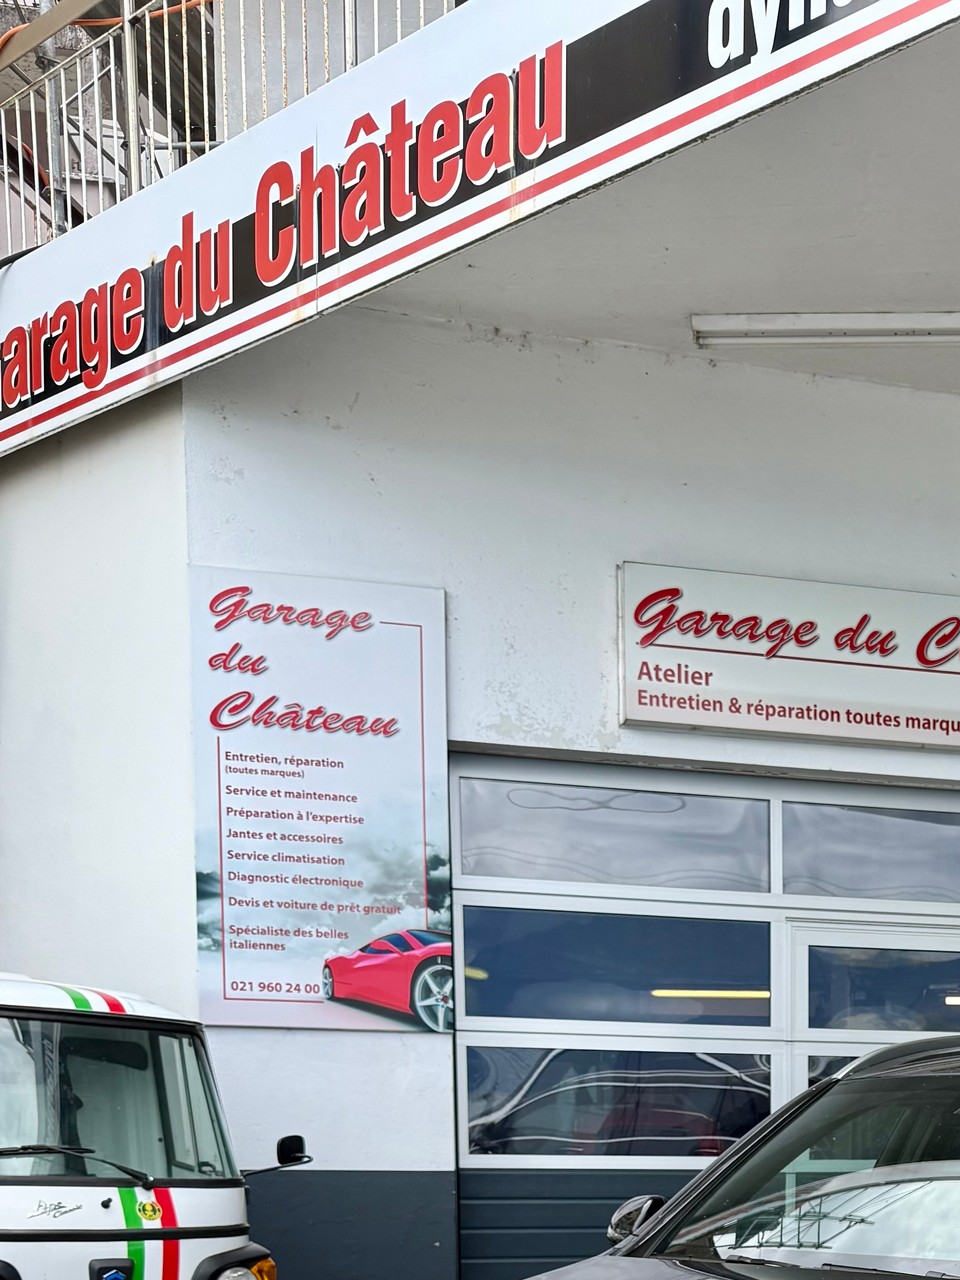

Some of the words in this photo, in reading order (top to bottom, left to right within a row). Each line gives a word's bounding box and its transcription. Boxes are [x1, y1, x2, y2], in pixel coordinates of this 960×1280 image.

[0, 267, 145, 408] arage
[163, 210, 233, 333] du
[254, 39, 567, 288] Château
[208, 585, 375, 640] Garage
[633, 587, 819, 659] Garage
[834, 613, 898, 657] du
[208, 641, 269, 676] du
[637, 661, 714, 687] Atelier
[209, 690, 400, 737] Château
[637, 689, 724, 713] Entretien
[728, 698, 742, 714] &
[746, 700, 841, 723] réparation
[845, 708, 901, 728] toutes
[224, 751, 281, 766] Entretien,
[284, 755, 344, 770] réparation
[225, 765, 259, 776] (toutes
[260, 767, 305, 779] marques)
[225, 785, 268, 798] Service
[270, 788, 282, 798] et
[284, 789, 358, 803] maintenance
[226, 806, 295, 821] Préparation
[296, 810, 304, 821] à
[226, 828, 264, 841] Jantes
[266, 831, 278, 841] et
[280, 833, 344, 845] accessoires
[227, 850, 269, 862] Service
[271, 852, 345, 867] climatisation
[228, 871, 290, 885] Diagnostic
[291, 874, 364, 889] électronique
[228, 897, 260, 908] Devis
[262, 899, 275, 909] et
[276, 900, 318, 911] voiture
[320, 901, 335, 911] de
[337, 902, 361, 914] prêt
[363, 904, 402, 916] gratuit
[229, 925, 291, 940] Spécialiste
[293, 928, 313, 938] des
[316, 928, 349, 940] belles
[229, 940, 287, 952] italiennes
[230, 981, 254, 992] 021
[258, 981, 282, 993] 960
[285, 982, 302, 993] 24
[304, 983, 320, 994] 00
